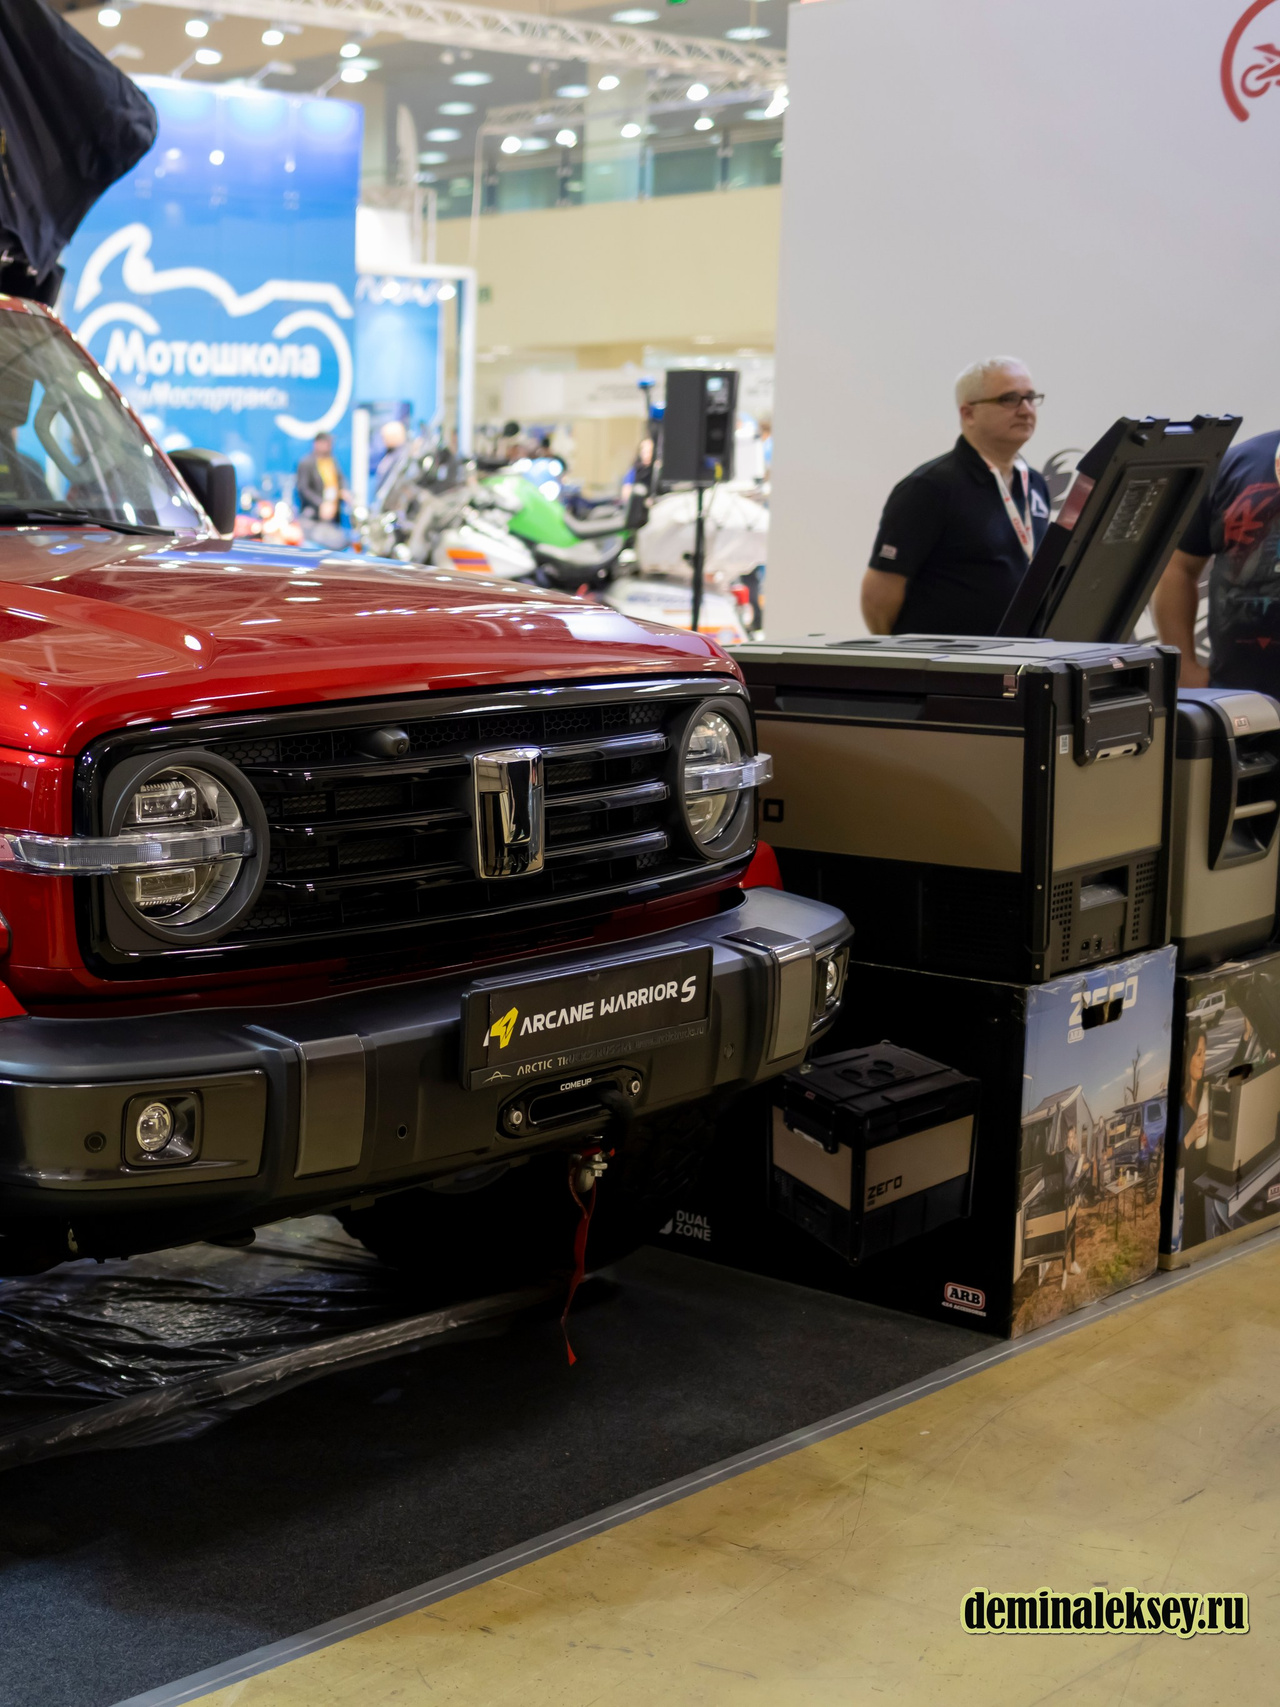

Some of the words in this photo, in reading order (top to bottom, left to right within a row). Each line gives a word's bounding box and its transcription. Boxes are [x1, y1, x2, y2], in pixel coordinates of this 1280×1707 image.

[103, 328, 322, 379] Мотошкола
[519, 1001, 594, 1037] ARCANE
[599, 981, 678, 1017] WARRIOR
[680, 975, 697, 1004] S
[516, 1058, 553, 1076] ARCTIC
[560, 1077, 593, 1092] COMEUP
[676, 1209, 712, 1229] DUAL
[675, 1222, 712, 1242] ZONE
[949, 1287, 981, 1305] ARB
